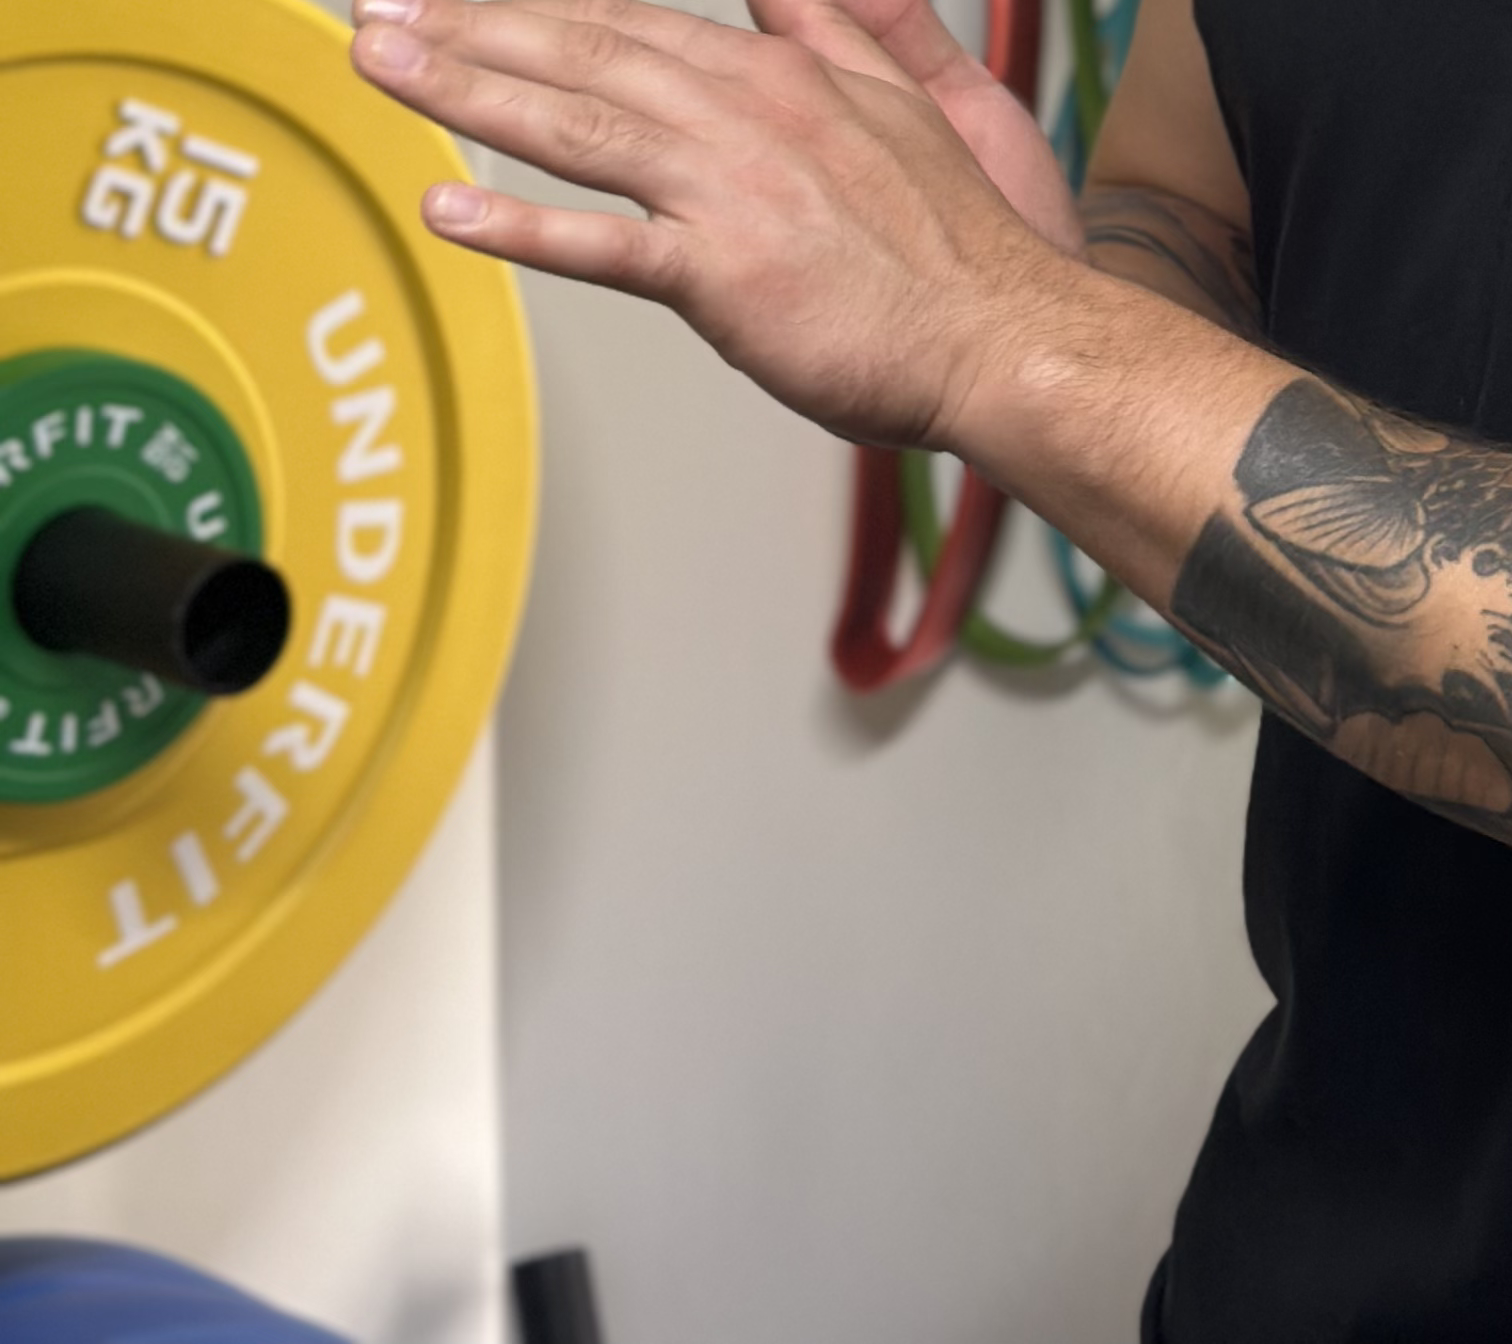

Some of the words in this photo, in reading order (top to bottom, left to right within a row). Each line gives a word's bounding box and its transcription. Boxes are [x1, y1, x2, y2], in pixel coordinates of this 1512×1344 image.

[82, 96, 182, 242] KG
[155, 134, 261, 260] 15
[96, 289, 402, 970] UNDERFIT
